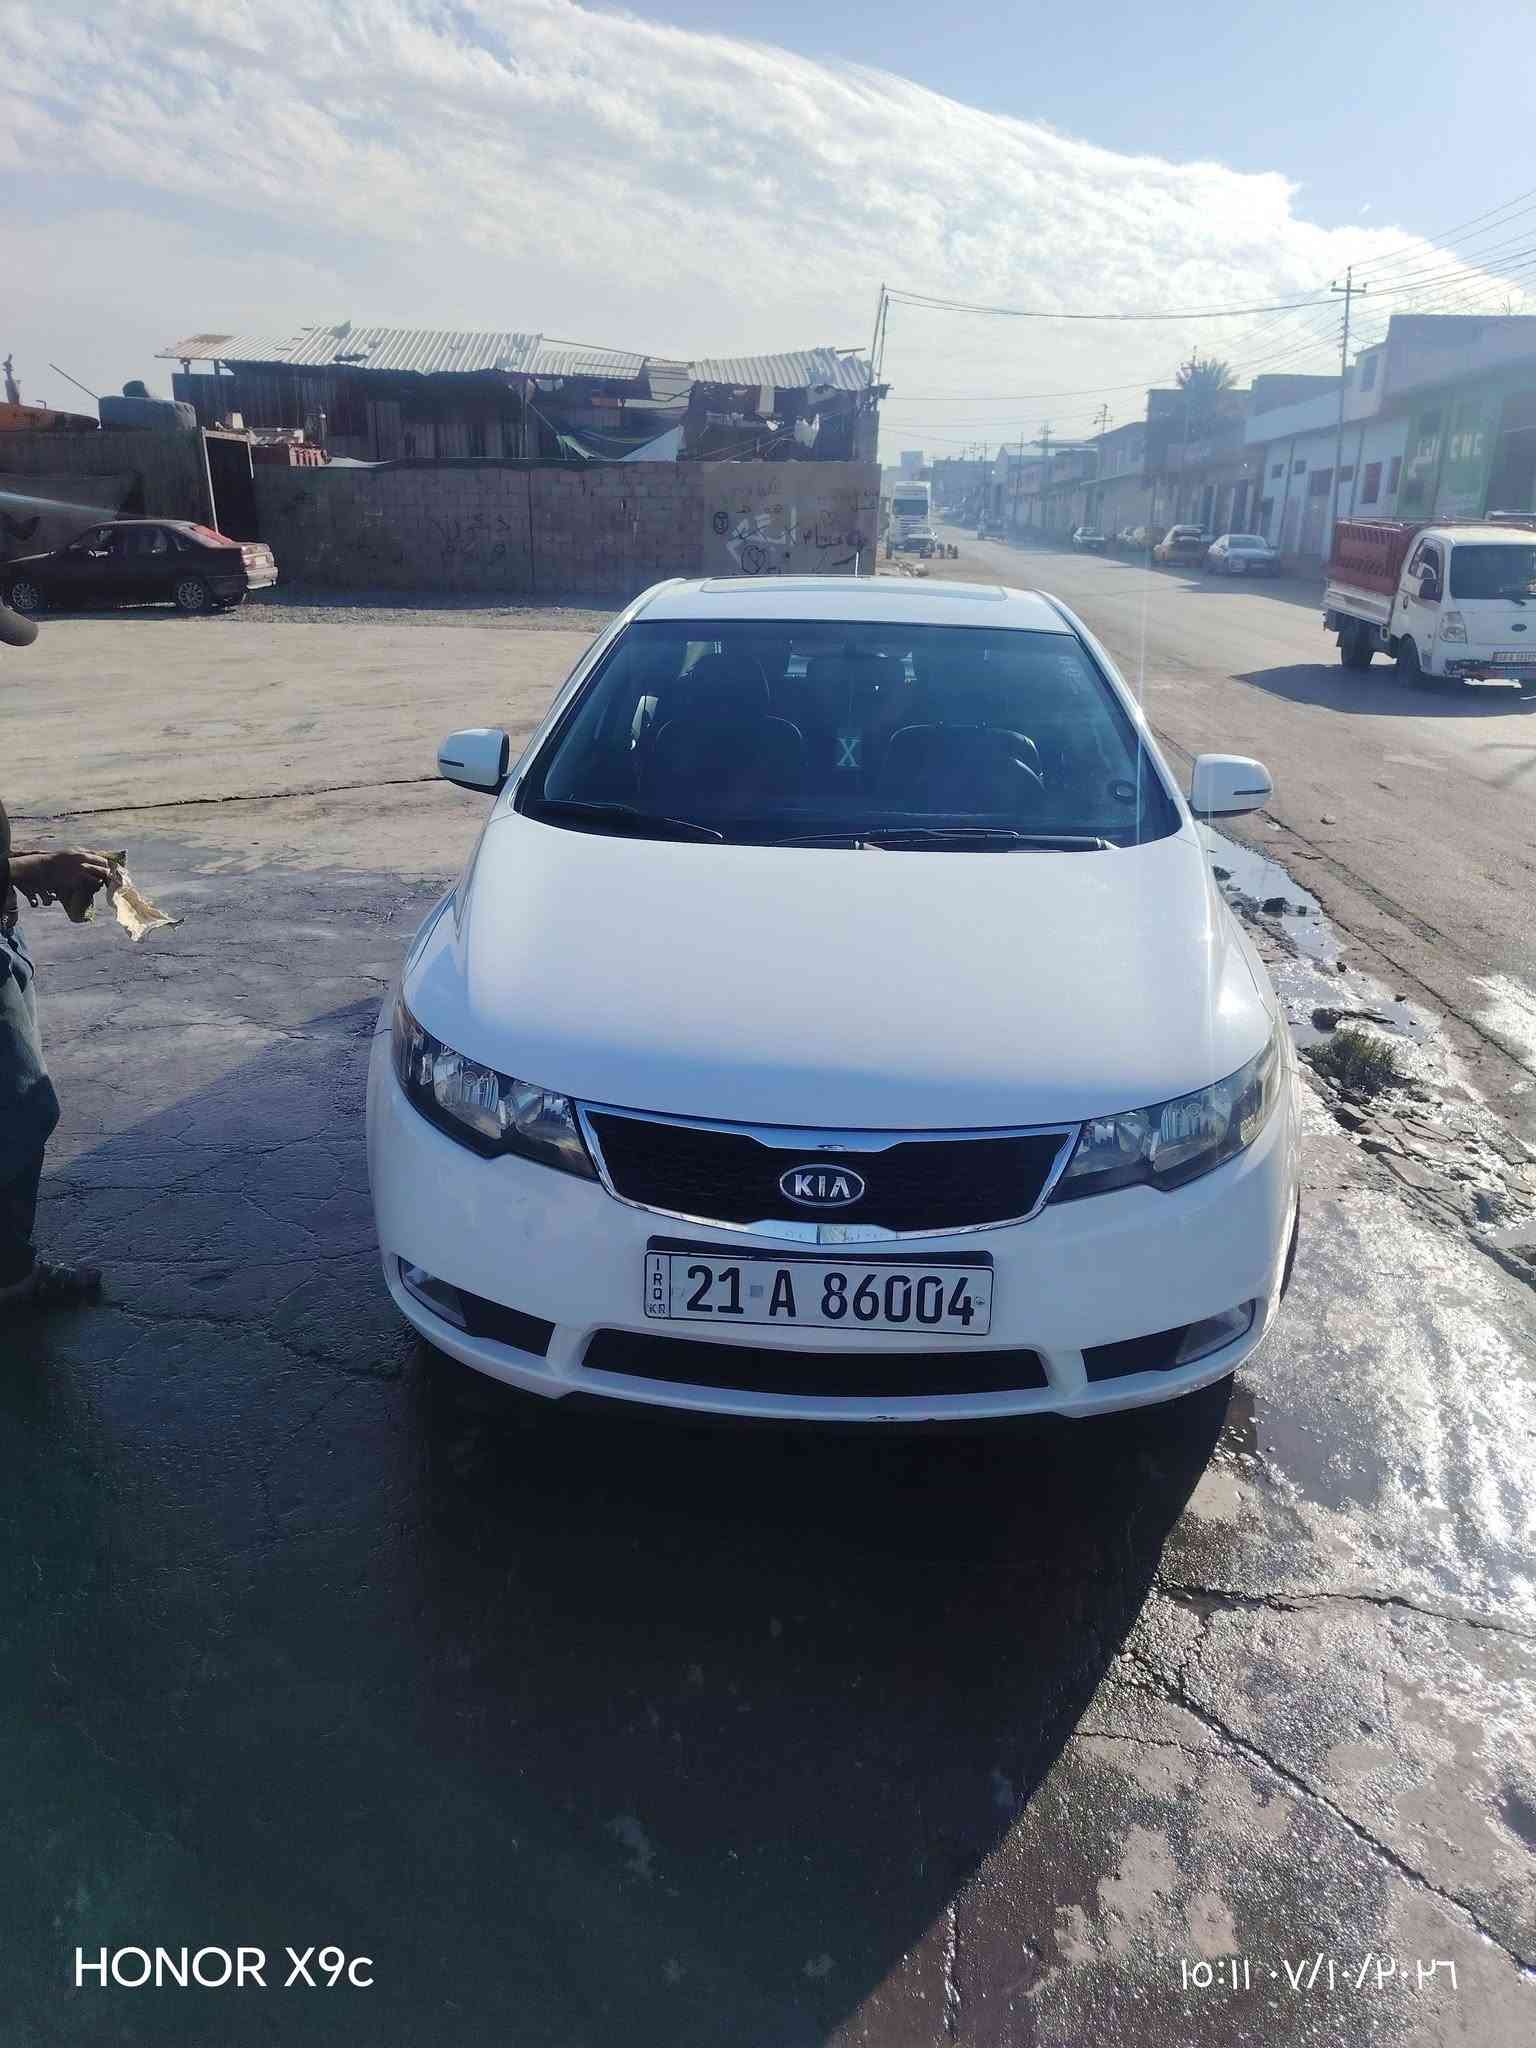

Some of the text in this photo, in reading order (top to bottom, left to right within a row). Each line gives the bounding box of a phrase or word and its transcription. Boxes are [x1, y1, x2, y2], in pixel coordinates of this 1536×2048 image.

[794, 1174, 851, 1198] KIA
[686, 1264, 976, 1327] 21 A 86004
